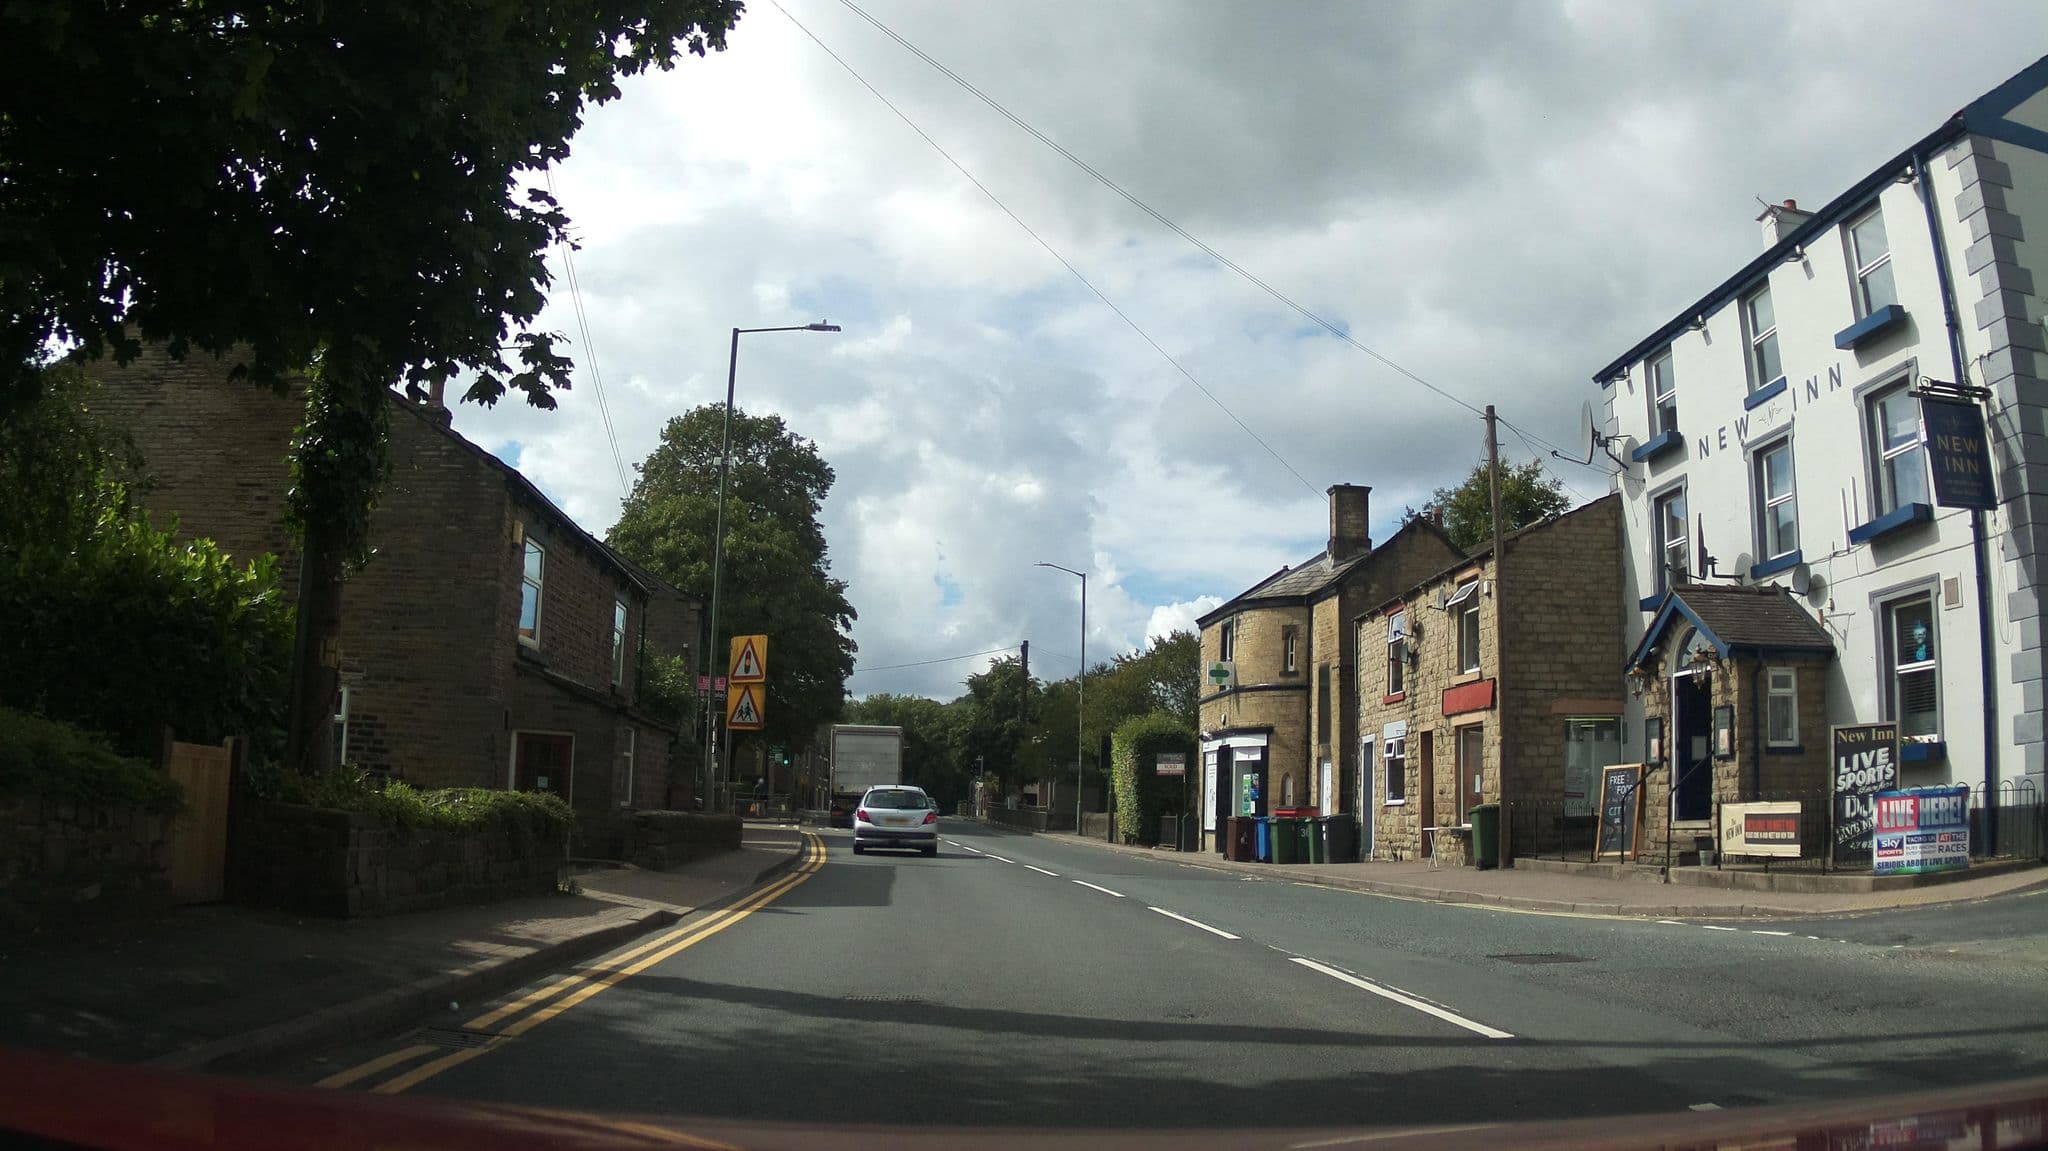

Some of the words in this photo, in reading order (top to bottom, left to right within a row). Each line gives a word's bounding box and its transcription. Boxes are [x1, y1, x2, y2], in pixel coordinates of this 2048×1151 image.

[1698, 413, 1749, 460] NEW
[1792, 362, 1842, 412] INN
[1936, 434, 1978, 454] NEW
[1944, 456, 1979, 474] INN
[1837, 729, 1868, 744] New
[1871, 727, 1895, 741] Inn
[1839, 746, 1890, 775] LIVE
[1609, 774, 1625, 785] FREE
[1836, 762, 1895, 792] SPORTS
[1882, 798, 1915, 829] LIVE
[1920, 795, 1962, 826] HERE!
[1881, 838, 1900, 849] sky
[1939, 834, 1949, 842] AT
[1951, 832, 1966, 841] THE
[1878, 849, 1904, 857] SPORTS
[1938, 843, 1967, 853] RACES
[1877, 861, 1905, 870] SERIOUS
[1906, 858, 1928, 868] ABOUT
